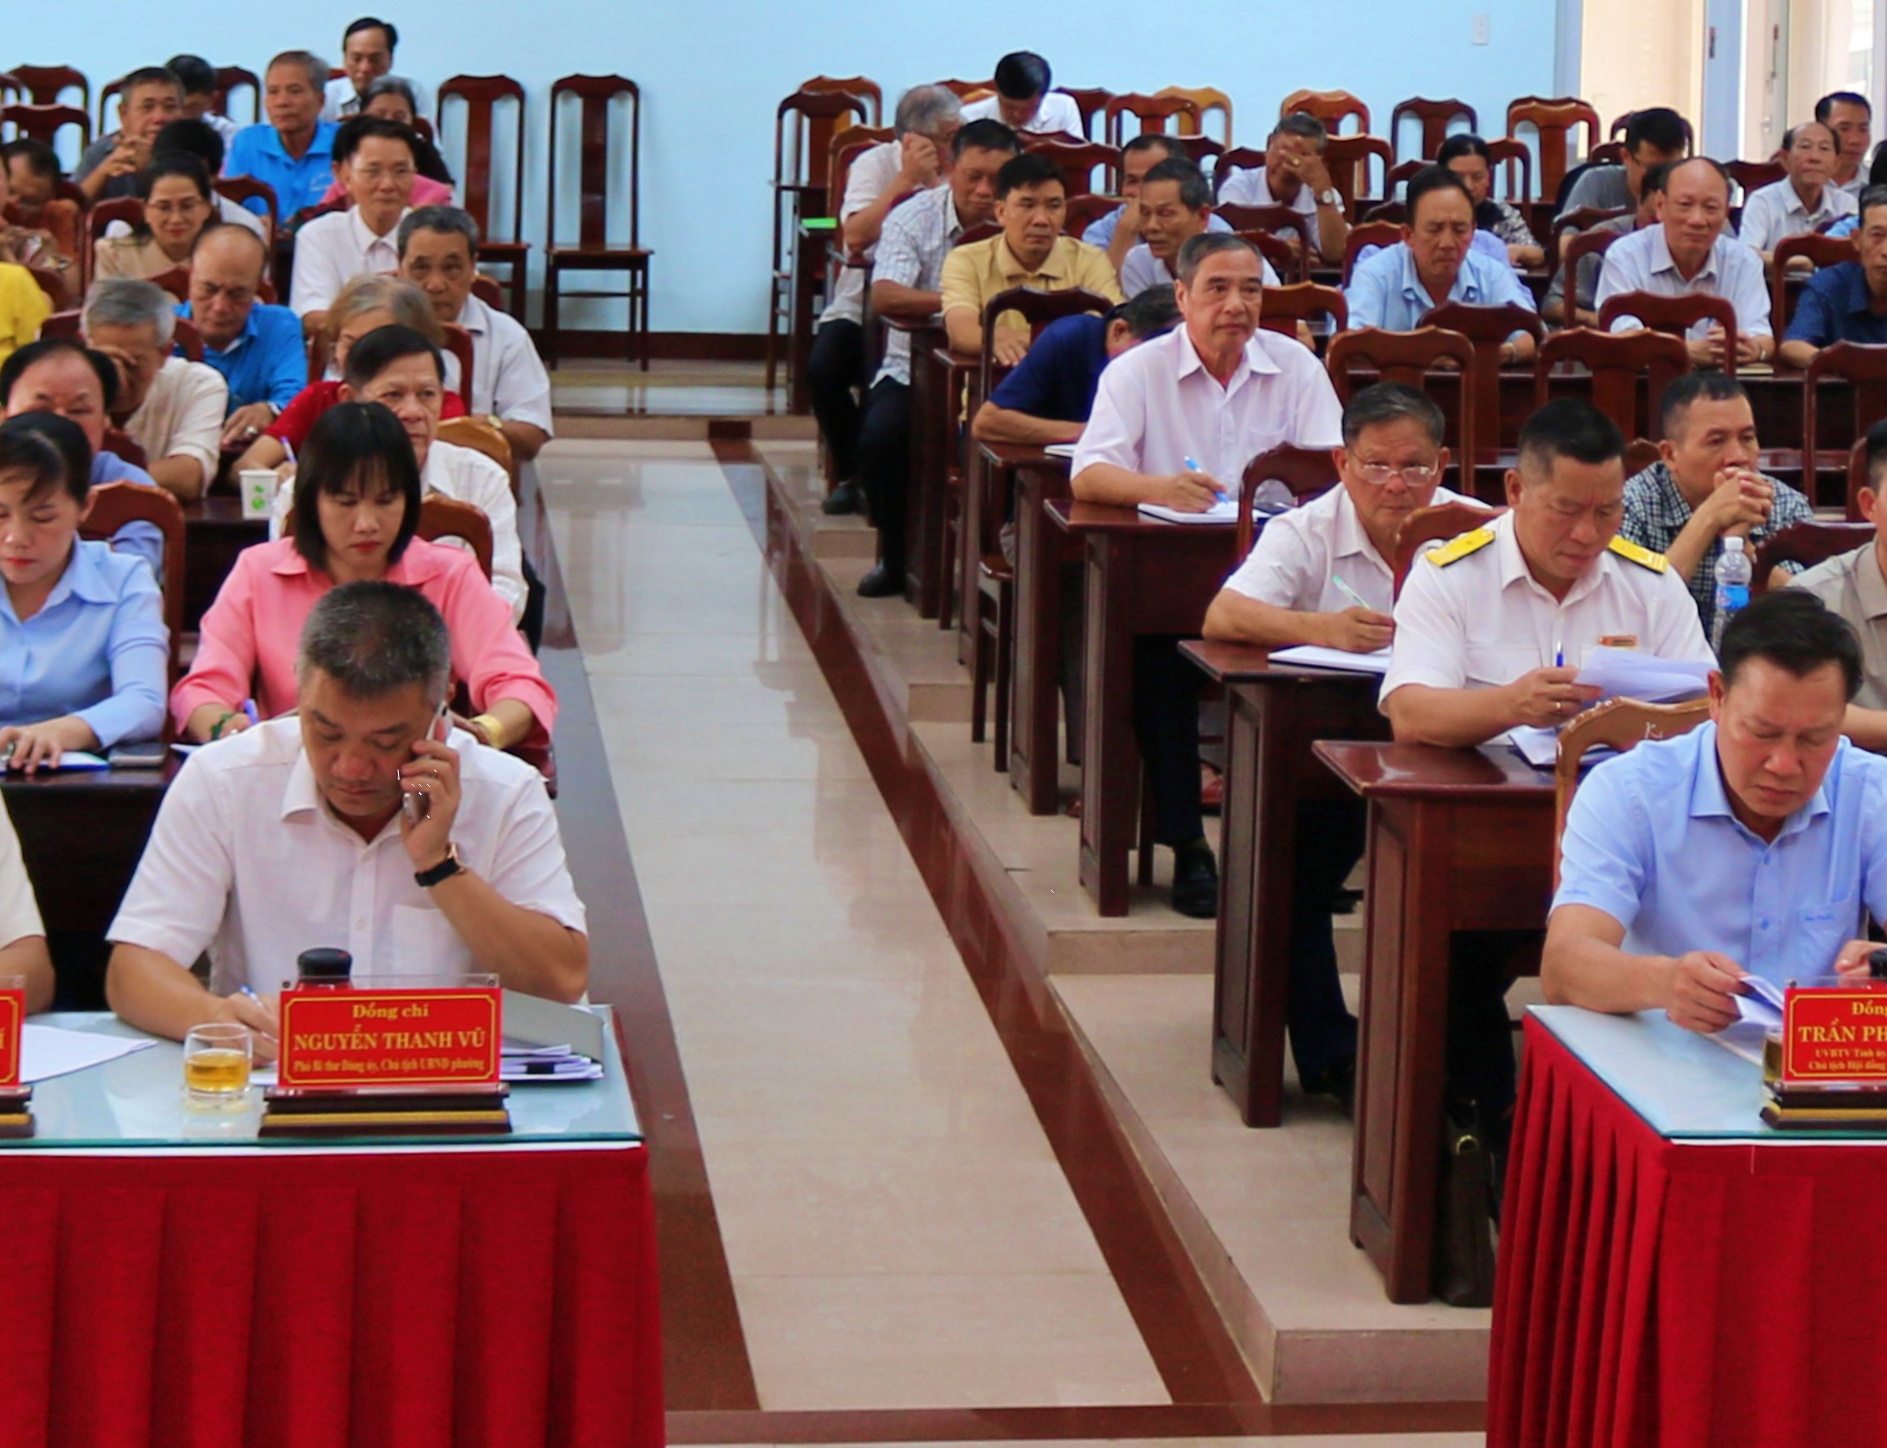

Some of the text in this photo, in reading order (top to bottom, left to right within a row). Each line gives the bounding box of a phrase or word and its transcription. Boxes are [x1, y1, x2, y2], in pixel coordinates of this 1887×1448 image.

[293, 1024, 485, 1051] NGUYỄN THANH VŨ
[1798, 1018, 1856, 1042] TRẦN
